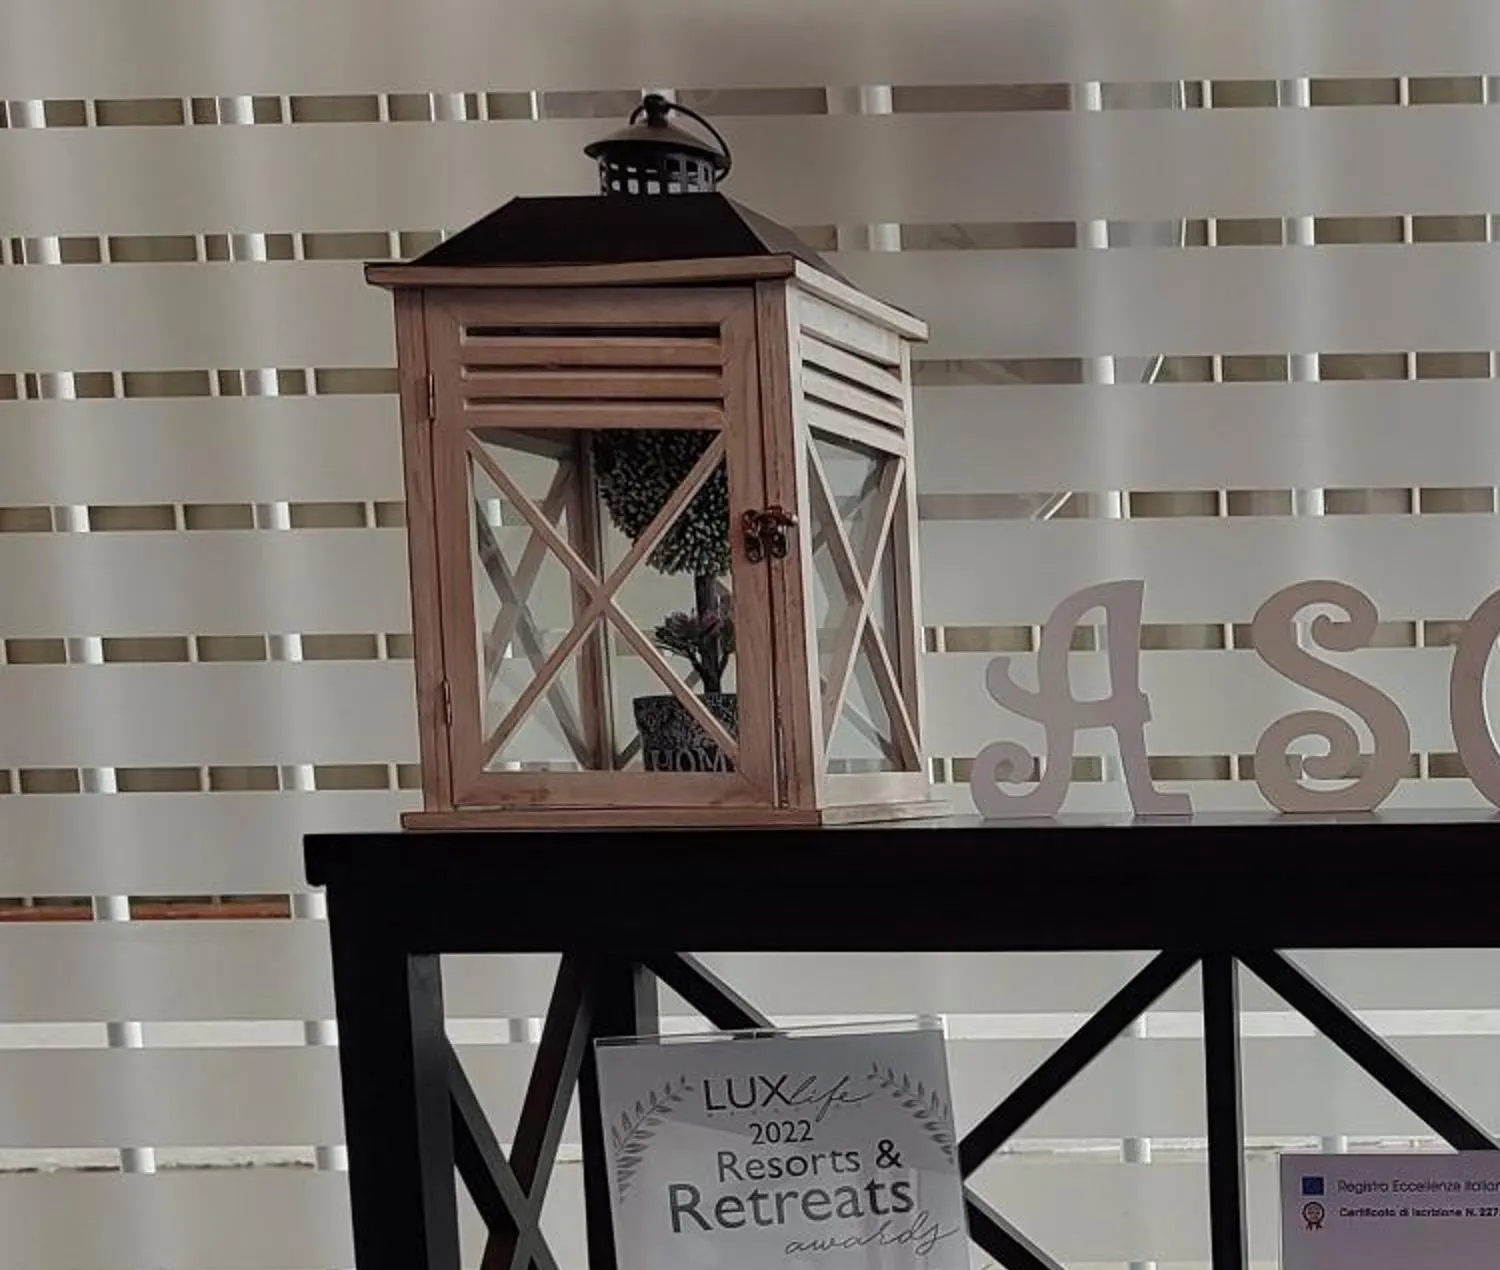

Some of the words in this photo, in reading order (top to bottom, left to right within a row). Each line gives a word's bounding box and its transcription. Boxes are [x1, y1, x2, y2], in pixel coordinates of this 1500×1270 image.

[749, 1119, 813, 1145] 2022
[717, 1150, 861, 1183] Resorts
[875, 1139, 903, 1169] &
[1337, 1179, 1389, 1195] Registro
[1392, 1179, 1461, 1193] Eccellenze
[668, 1177, 915, 1233] Retreats
[1339, 1206, 1396, 1217] Certificato
[1399, 1206, 1410, 1217] di
[784, 1211, 959, 1255] awards
